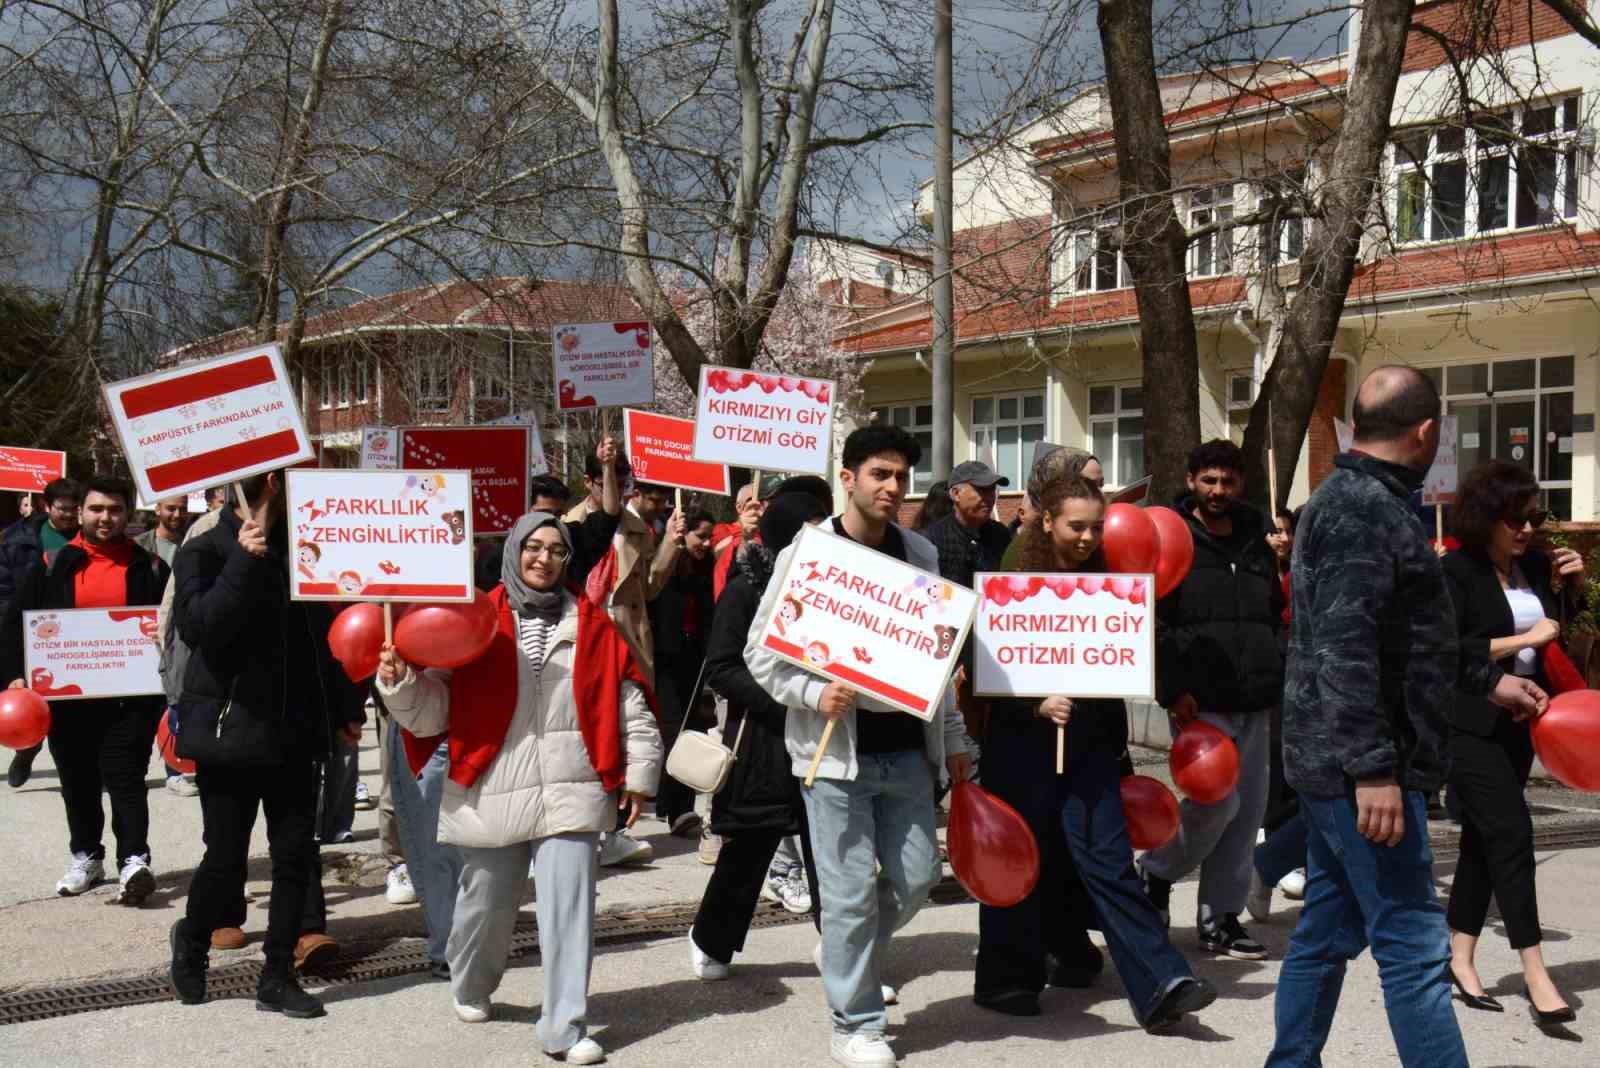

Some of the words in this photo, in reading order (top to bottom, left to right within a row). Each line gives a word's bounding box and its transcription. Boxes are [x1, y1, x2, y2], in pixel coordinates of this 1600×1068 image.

[138, 424, 195, 447] KAMPÜSTE
[196, 407, 262, 432] FARKINDALIK
[262, 400, 285, 414] VAR
[709, 399, 791, 421] KIRMIZIYI
[796, 408, 827, 425] GİY
[635, 435, 652, 445] HER
[712, 424, 772, 445] OTİZMİ
[777, 432, 817, 450] GÖR
[325, 499, 429, 516] FARKLILIK
[313, 524, 450, 544] ZENGİNLİKTİR
[825, 565, 928, 620] FARKLILIK
[800, 587, 935, 656] ZENGİNLİKTİR
[989, 614, 1097, 633] KIRMIZIYI
[1104, 612, 1144, 633] GİY
[33, 640, 61, 650] OTİZM
[81, 638, 124, 648] HASTALIK
[997, 643, 1075, 665] OTİZMİ
[1083, 643, 1136, 666] GÖR
